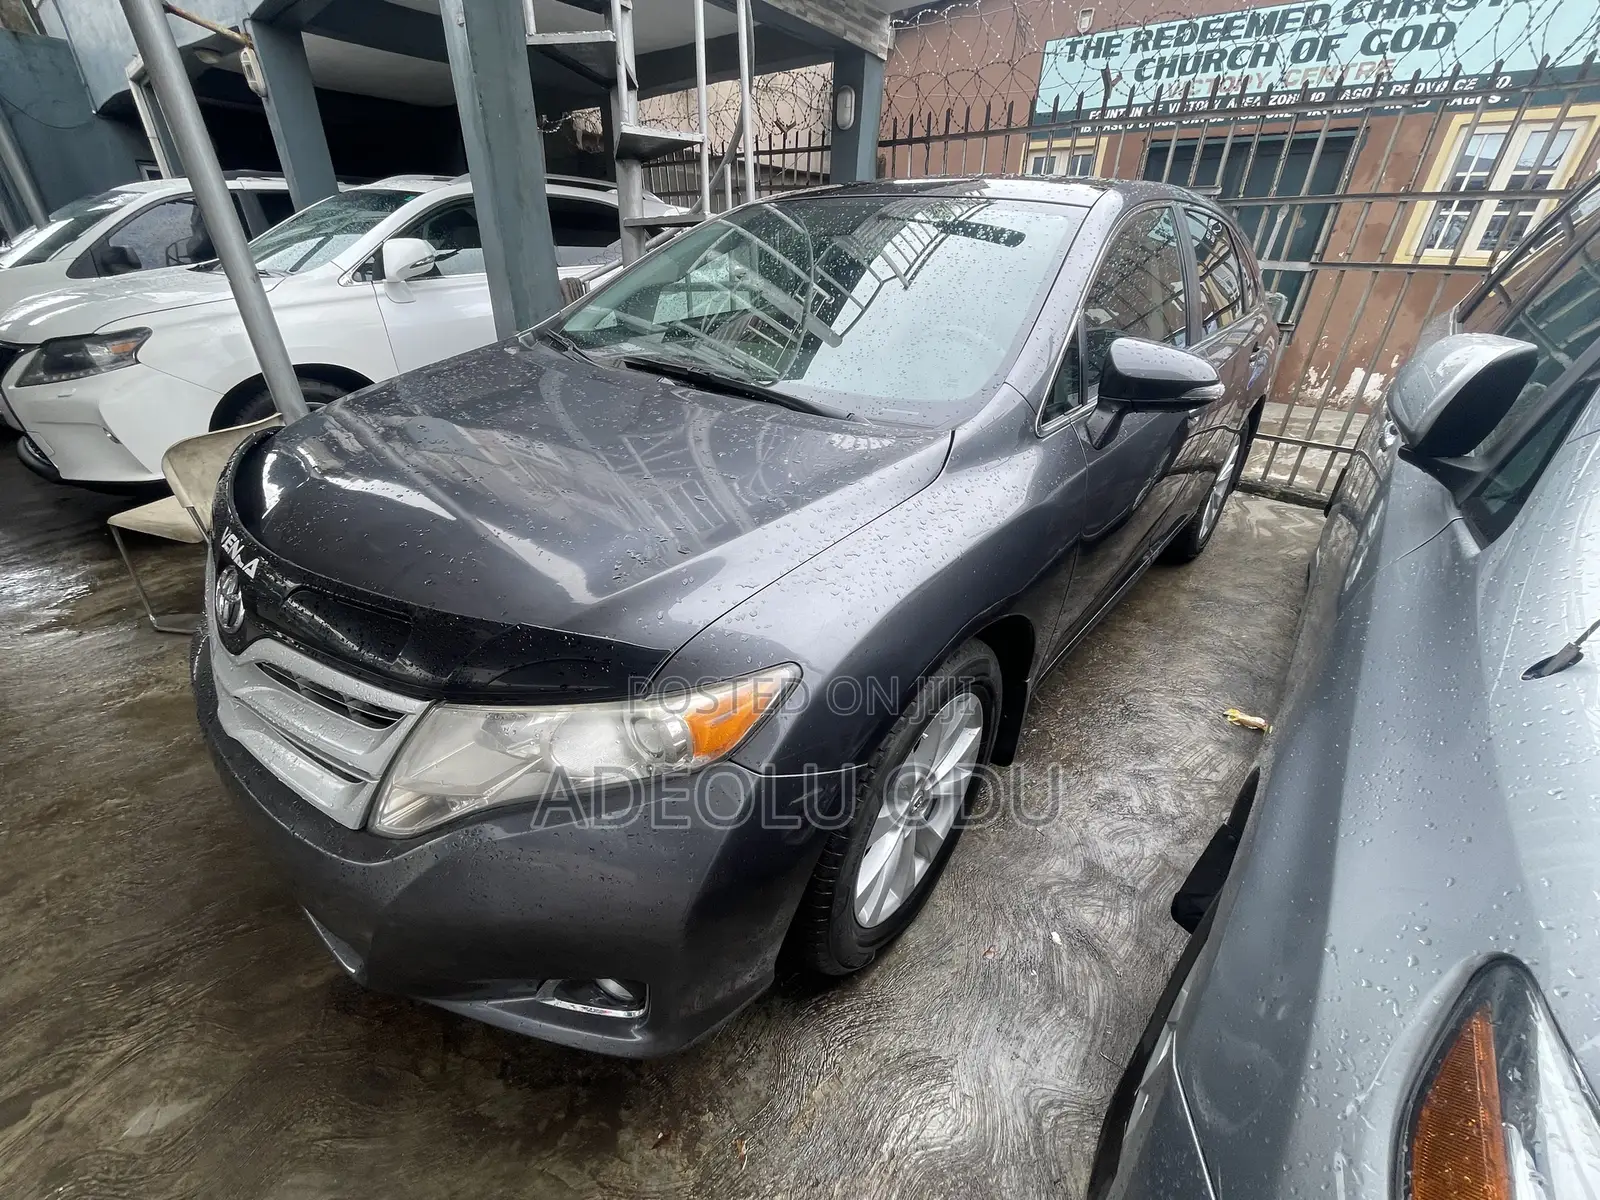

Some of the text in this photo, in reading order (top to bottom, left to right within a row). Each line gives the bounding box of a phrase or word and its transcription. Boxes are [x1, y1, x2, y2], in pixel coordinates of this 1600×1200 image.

[1066, 35, 1123, 63] THE
[1129, 4, 1323, 54] REDEEMED
[1133, 22, 1456, 83] CHURCH OF GOD
[1167, 70, 1273, 99] VCTORY
